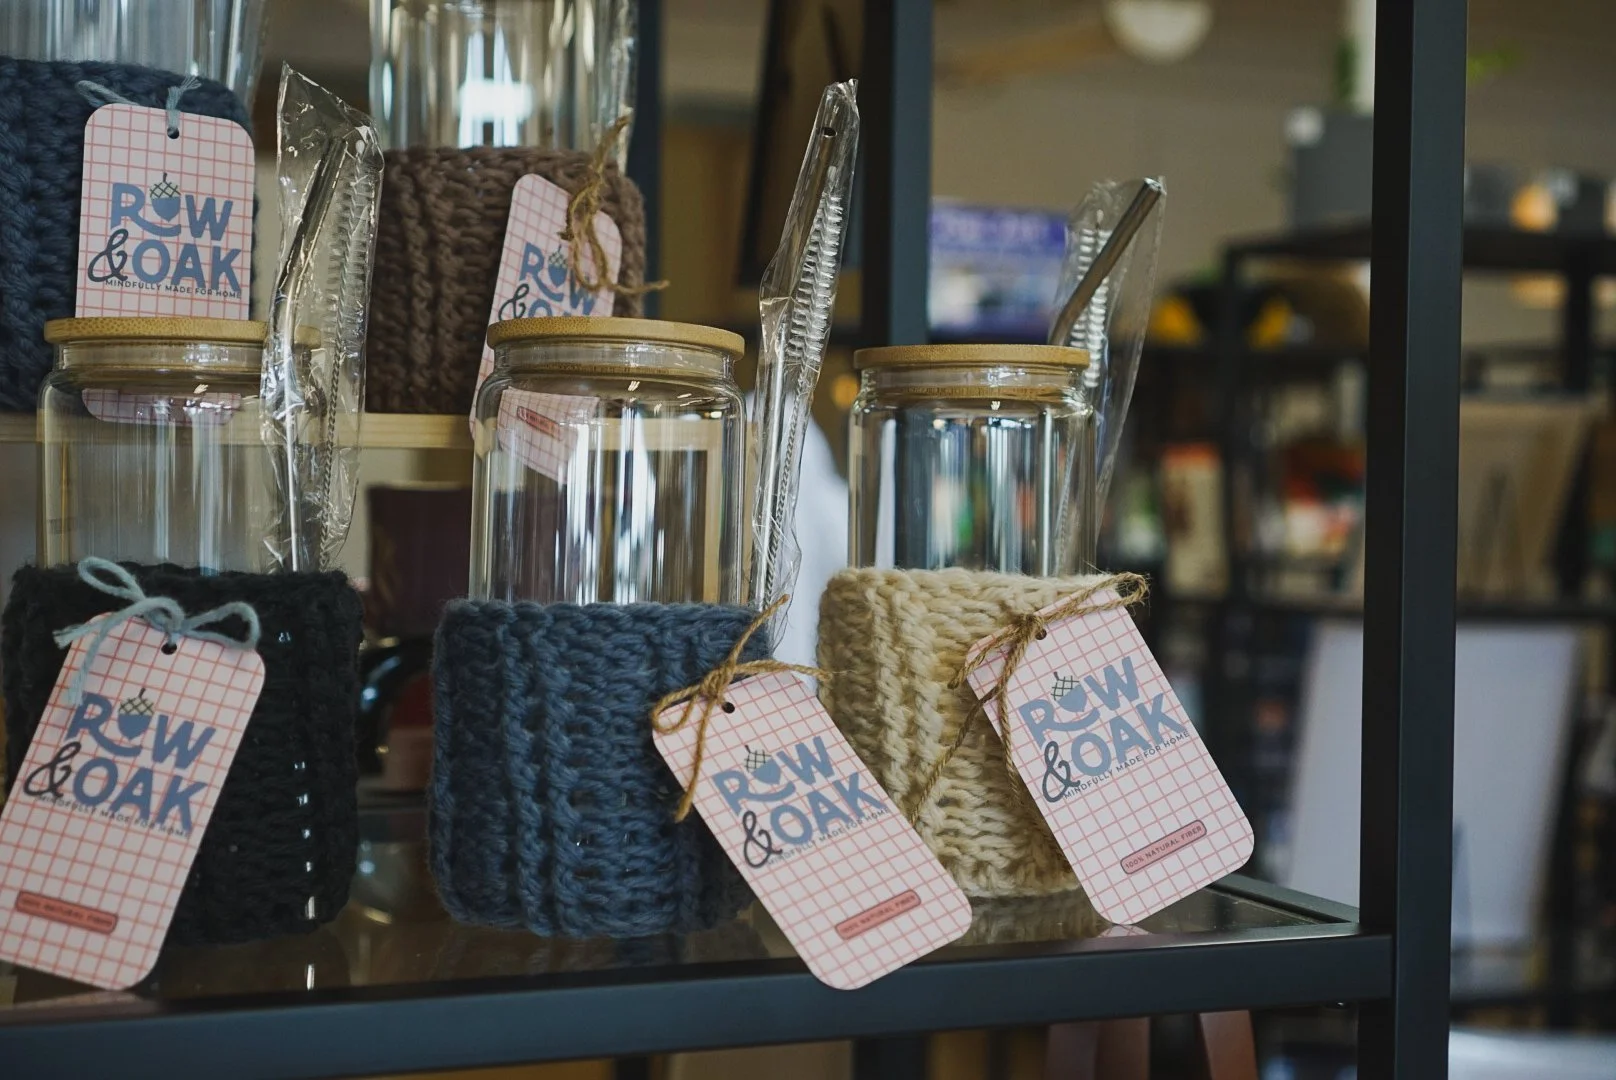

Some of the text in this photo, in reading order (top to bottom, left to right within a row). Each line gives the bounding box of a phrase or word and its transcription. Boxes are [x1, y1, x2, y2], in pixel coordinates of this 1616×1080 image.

[87, 228, 242, 293] & OAK
[105, 278, 242, 299] MINDFULLY MADE FOR HOME
[1042, 693, 1187, 803] & OAK
[1063, 730, 1191, 800] MINDFULLY MADE FOR HOME
[23, 741, 208, 833] & OAK
[742, 772, 888, 869] & OAK
[768, 807, 891, 866] MINDFULLY MADE FOR HOME
[1145, 838, 1179, 859] NATURAL
[1180, 825, 1202, 840] FIBER
